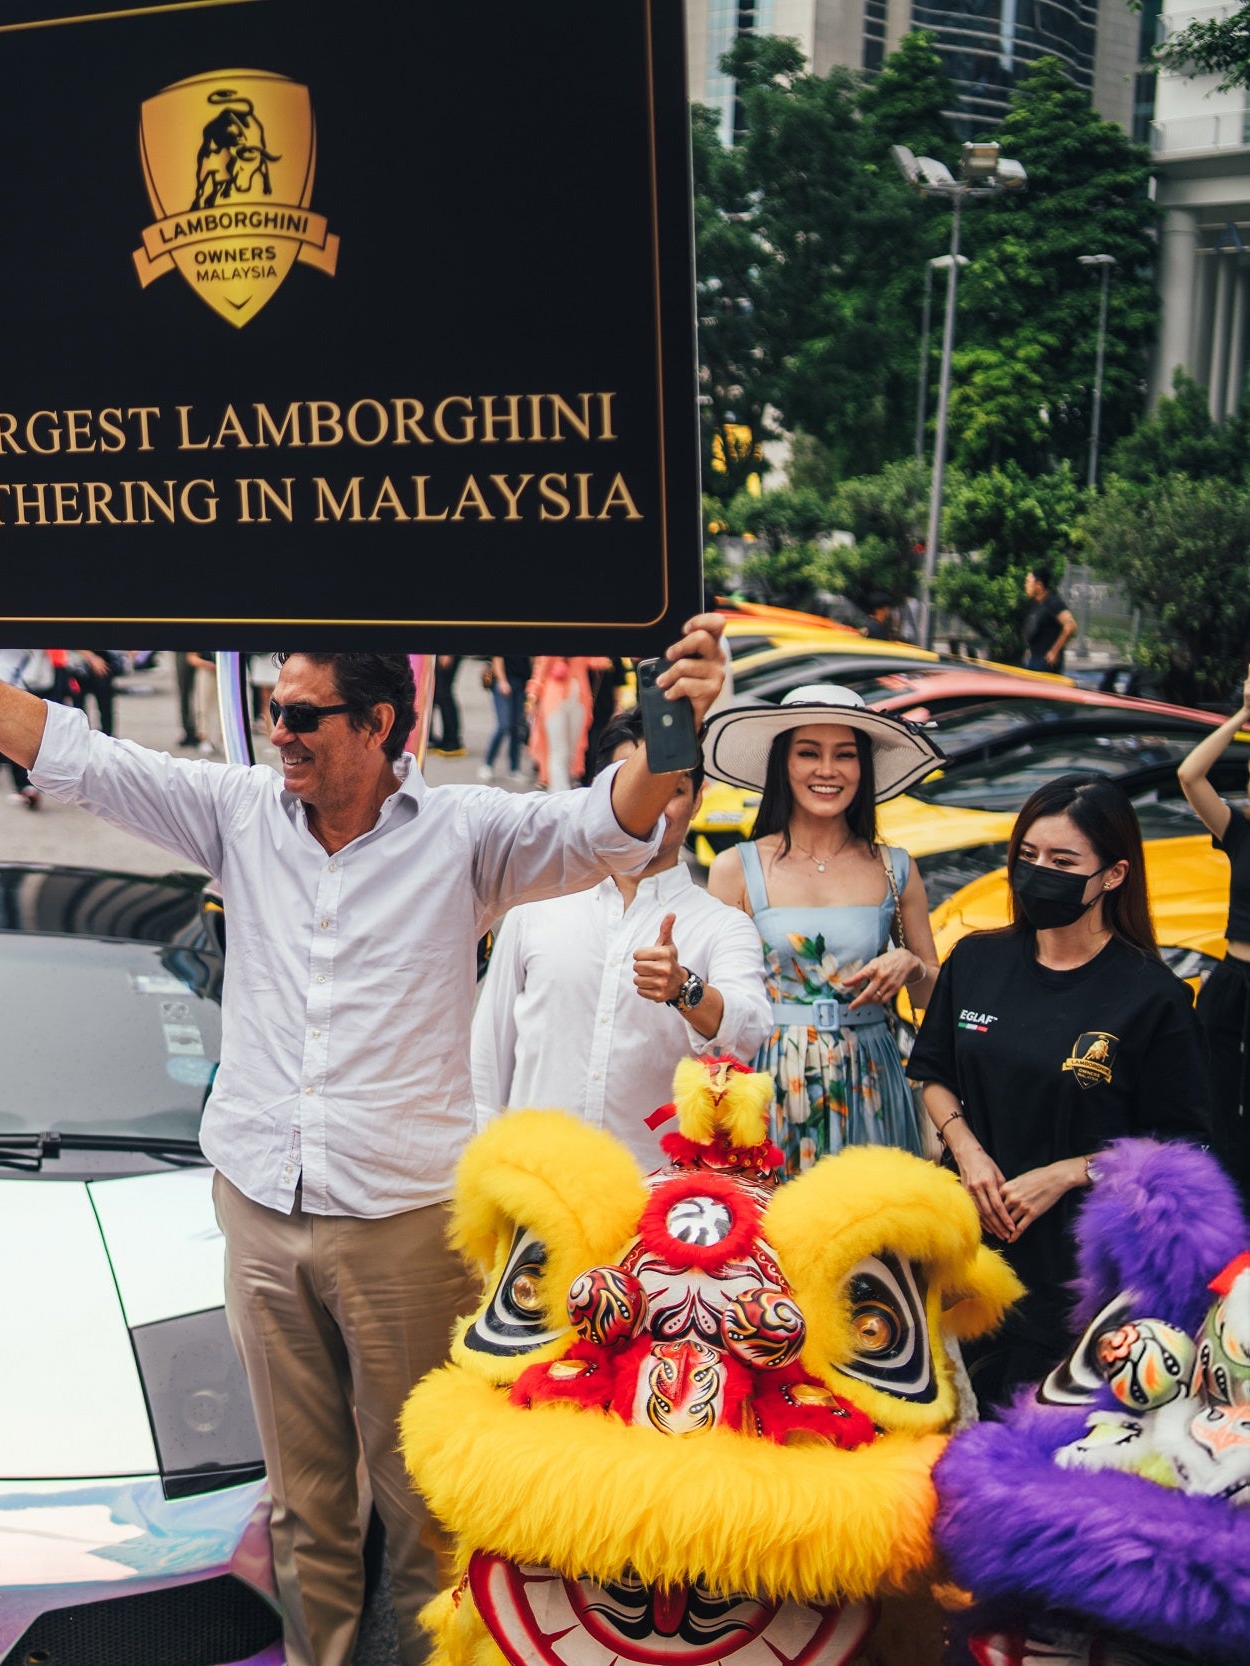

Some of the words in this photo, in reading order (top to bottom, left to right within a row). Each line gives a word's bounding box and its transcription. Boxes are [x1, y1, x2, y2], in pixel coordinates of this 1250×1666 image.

[159, 211, 309, 244] LAMBORGHINI
[194, 246, 276, 264] OWNERS
[196, 265, 277, 282] MALAYSIA
[176, 392, 618, 450] LAMBORGHINI
[236, 477, 296, 523] IN
[313, 472, 644, 522] MALAYSIA
